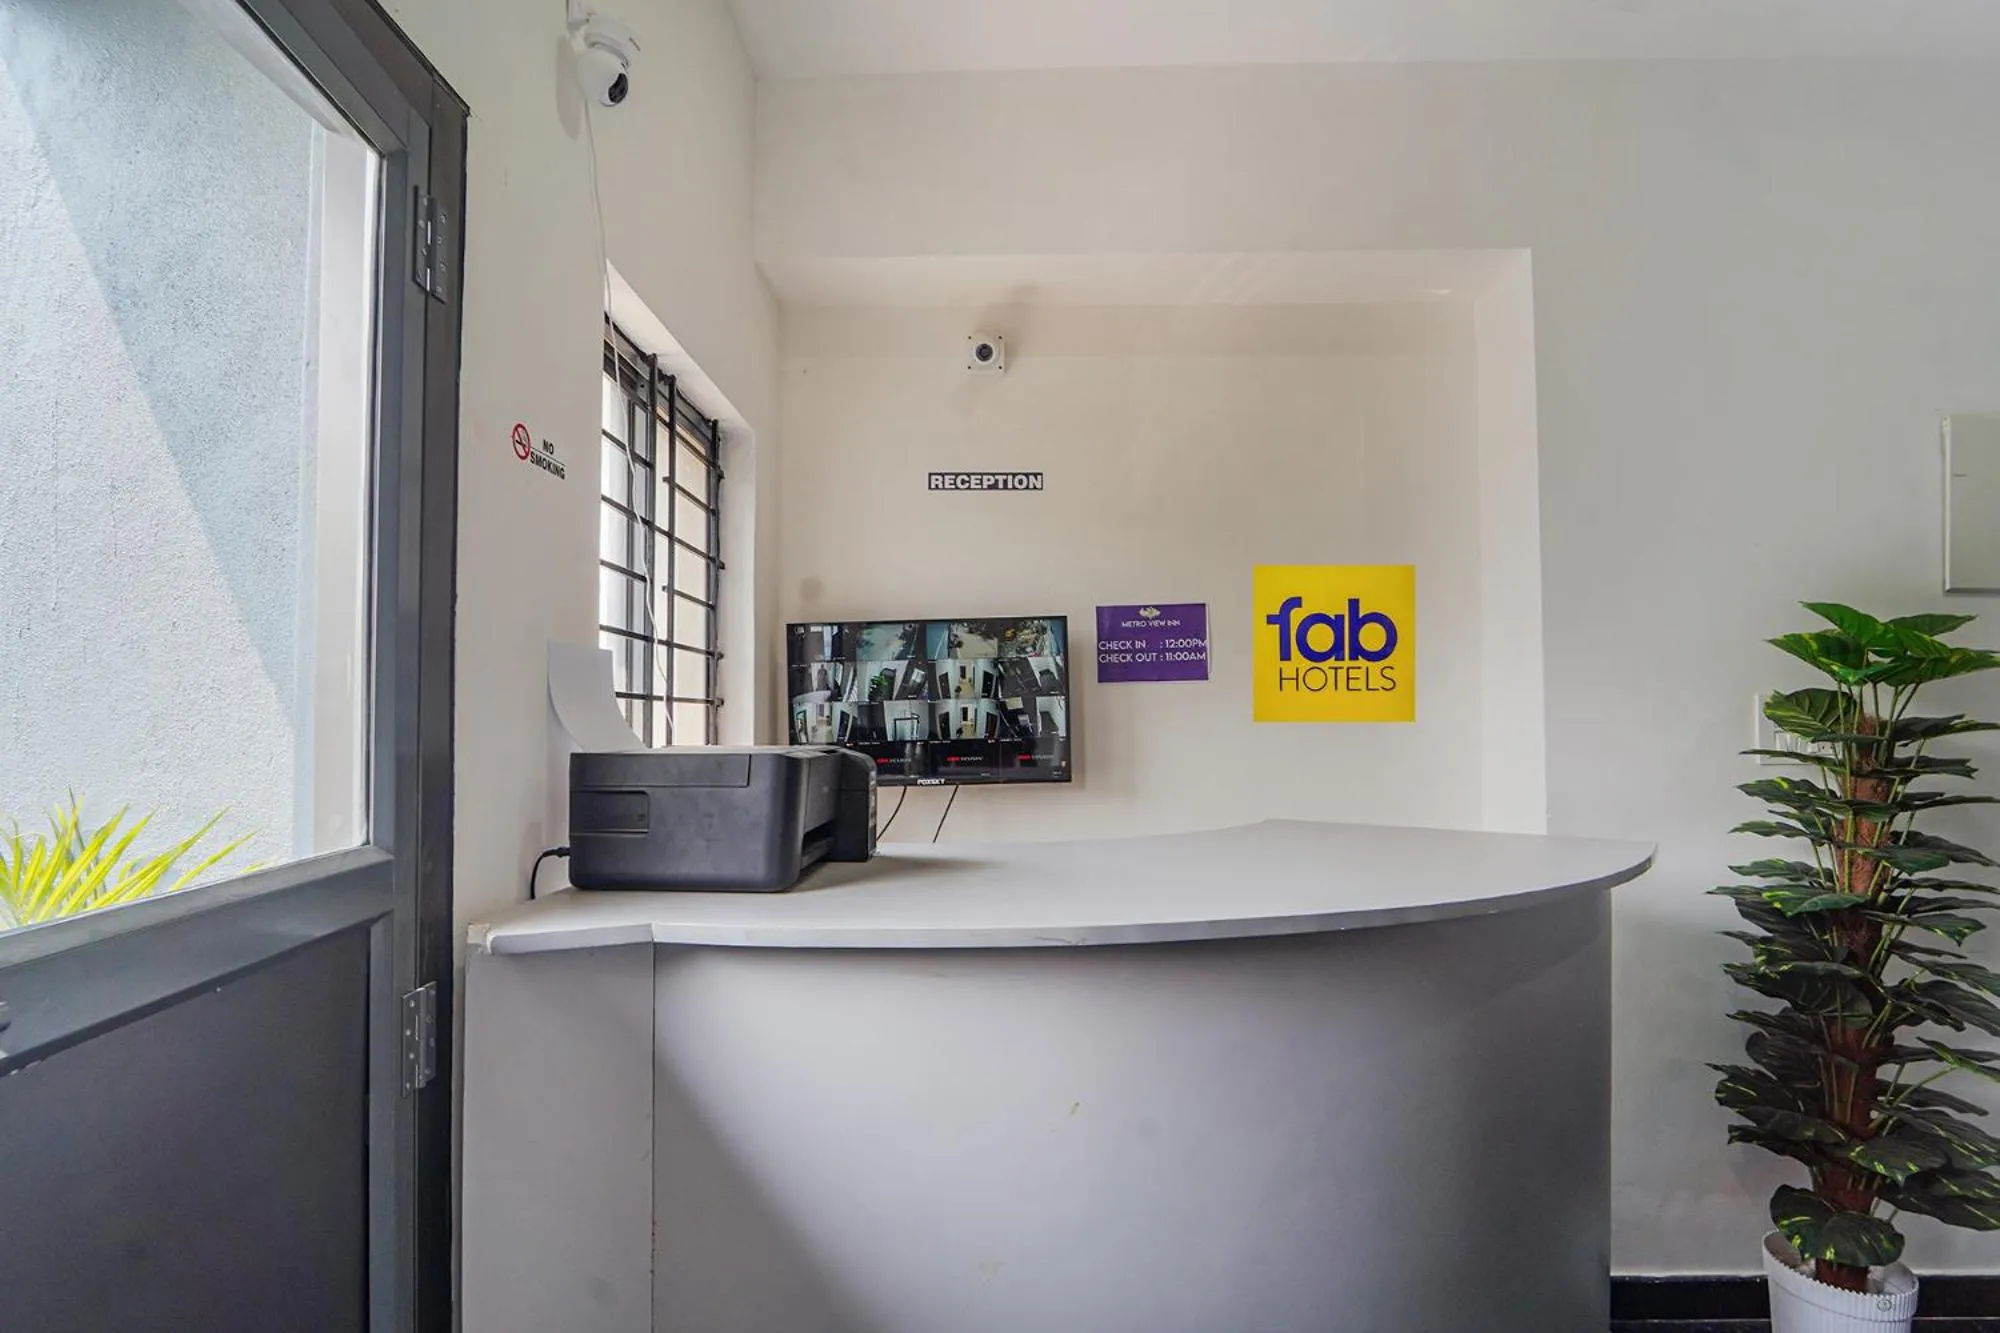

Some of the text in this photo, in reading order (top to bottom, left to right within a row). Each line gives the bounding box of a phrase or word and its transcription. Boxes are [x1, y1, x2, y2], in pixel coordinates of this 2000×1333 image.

[543, 439, 554, 455] NO
[530, 451, 565, 480] SMOKING
[930, 474, 1042, 489] RECEPTION
[1266, 596, 1398, 662] fab
[1098, 640, 1133, 650] CHECK
[1135, 640, 1146, 649] IN
[1099, 653, 1133, 664] CHECK
[1135, 653, 1158, 662] OUT
[1165, 652, 1206, 661] 11:00AM
[1279, 666, 1397, 692] HOTELS
